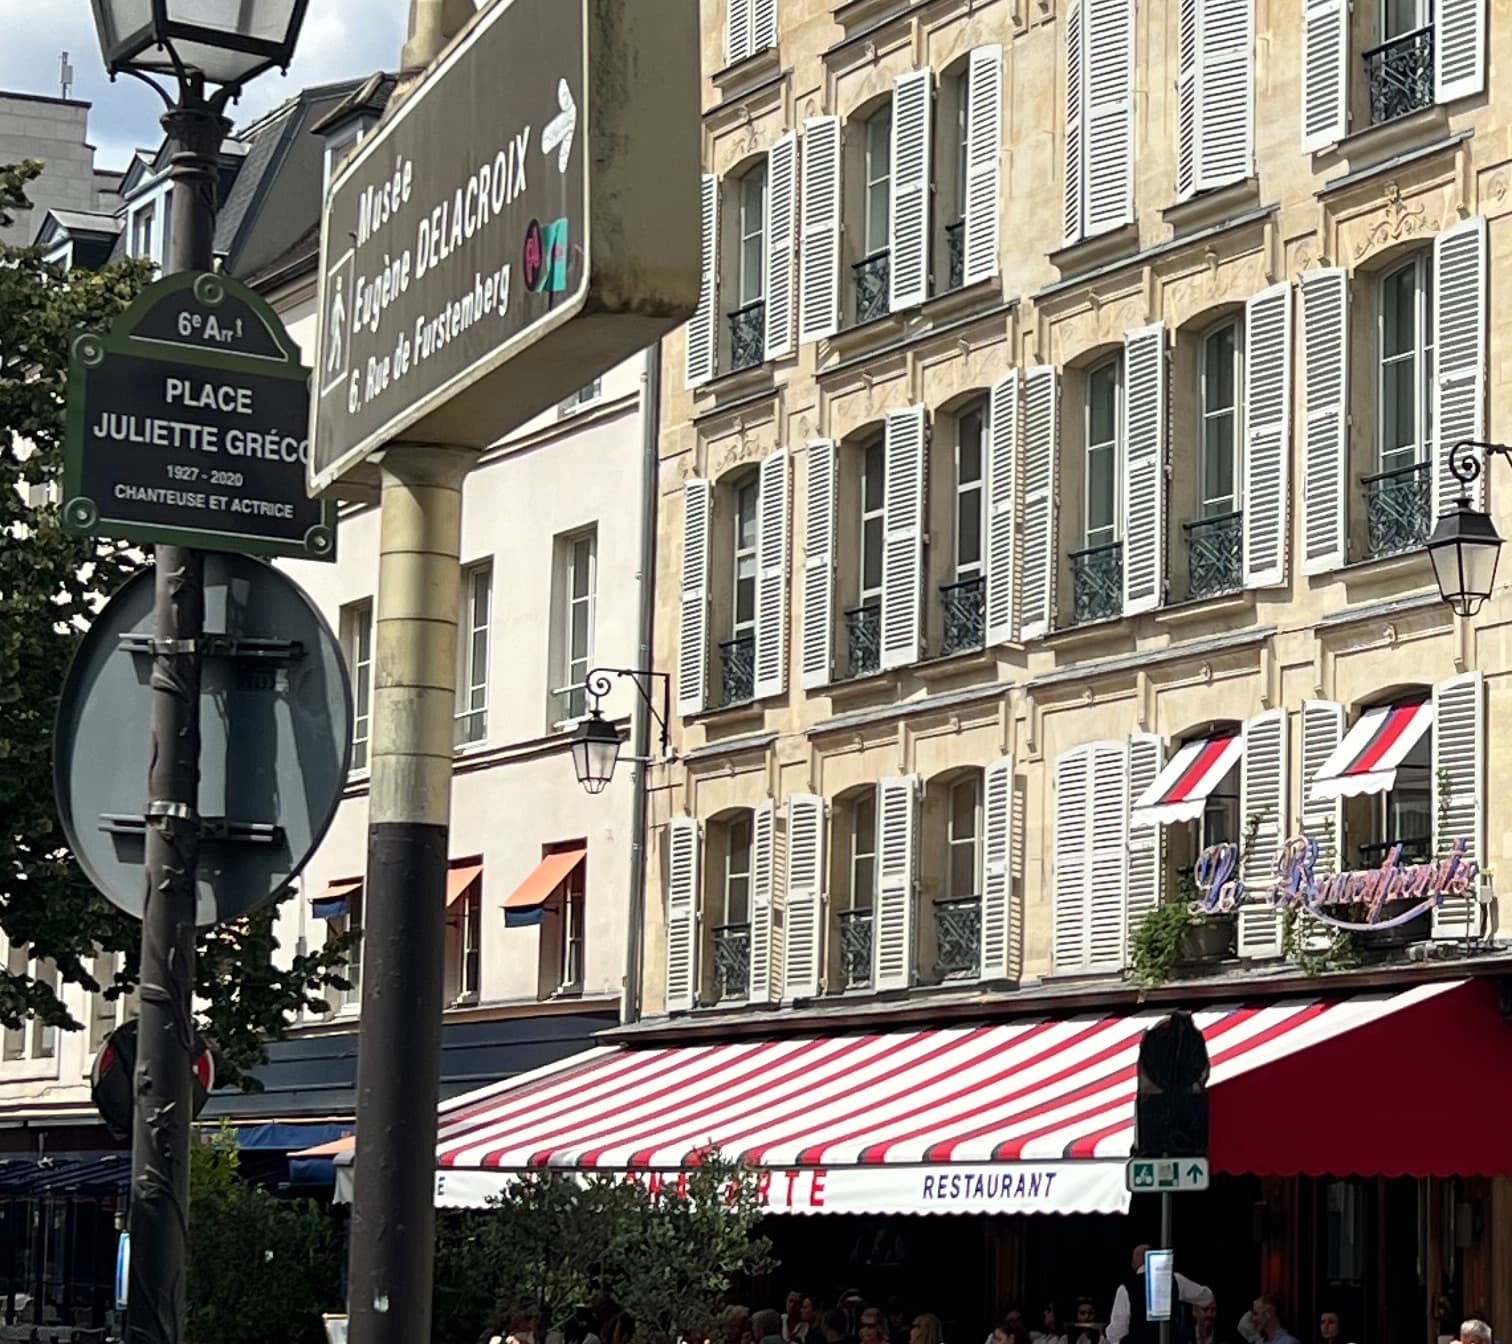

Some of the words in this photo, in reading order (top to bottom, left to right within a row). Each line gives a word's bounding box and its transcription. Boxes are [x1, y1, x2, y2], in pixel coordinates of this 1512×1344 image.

[357, 155, 412, 247] Musée
[353, 250, 410, 333] Eugène
[415, 126, 530, 279] DELACROIX
[364, 356, 390, 402] Rue
[393, 332, 411, 380] de
[413, 264, 511, 365] Furstemberg
[166, 378, 253, 414] PLACE
[93, 412, 218, 452] JULIETTE
[167, 465, 199, 481] 1927
[210, 470, 243, 487] 2020
[114, 485, 205, 508] CHANTEUSE
[209, 496, 229, 511] ET
[230, 498, 294, 519] ACTRICE
[923, 1172, 1057, 1199] RESTAURANT
